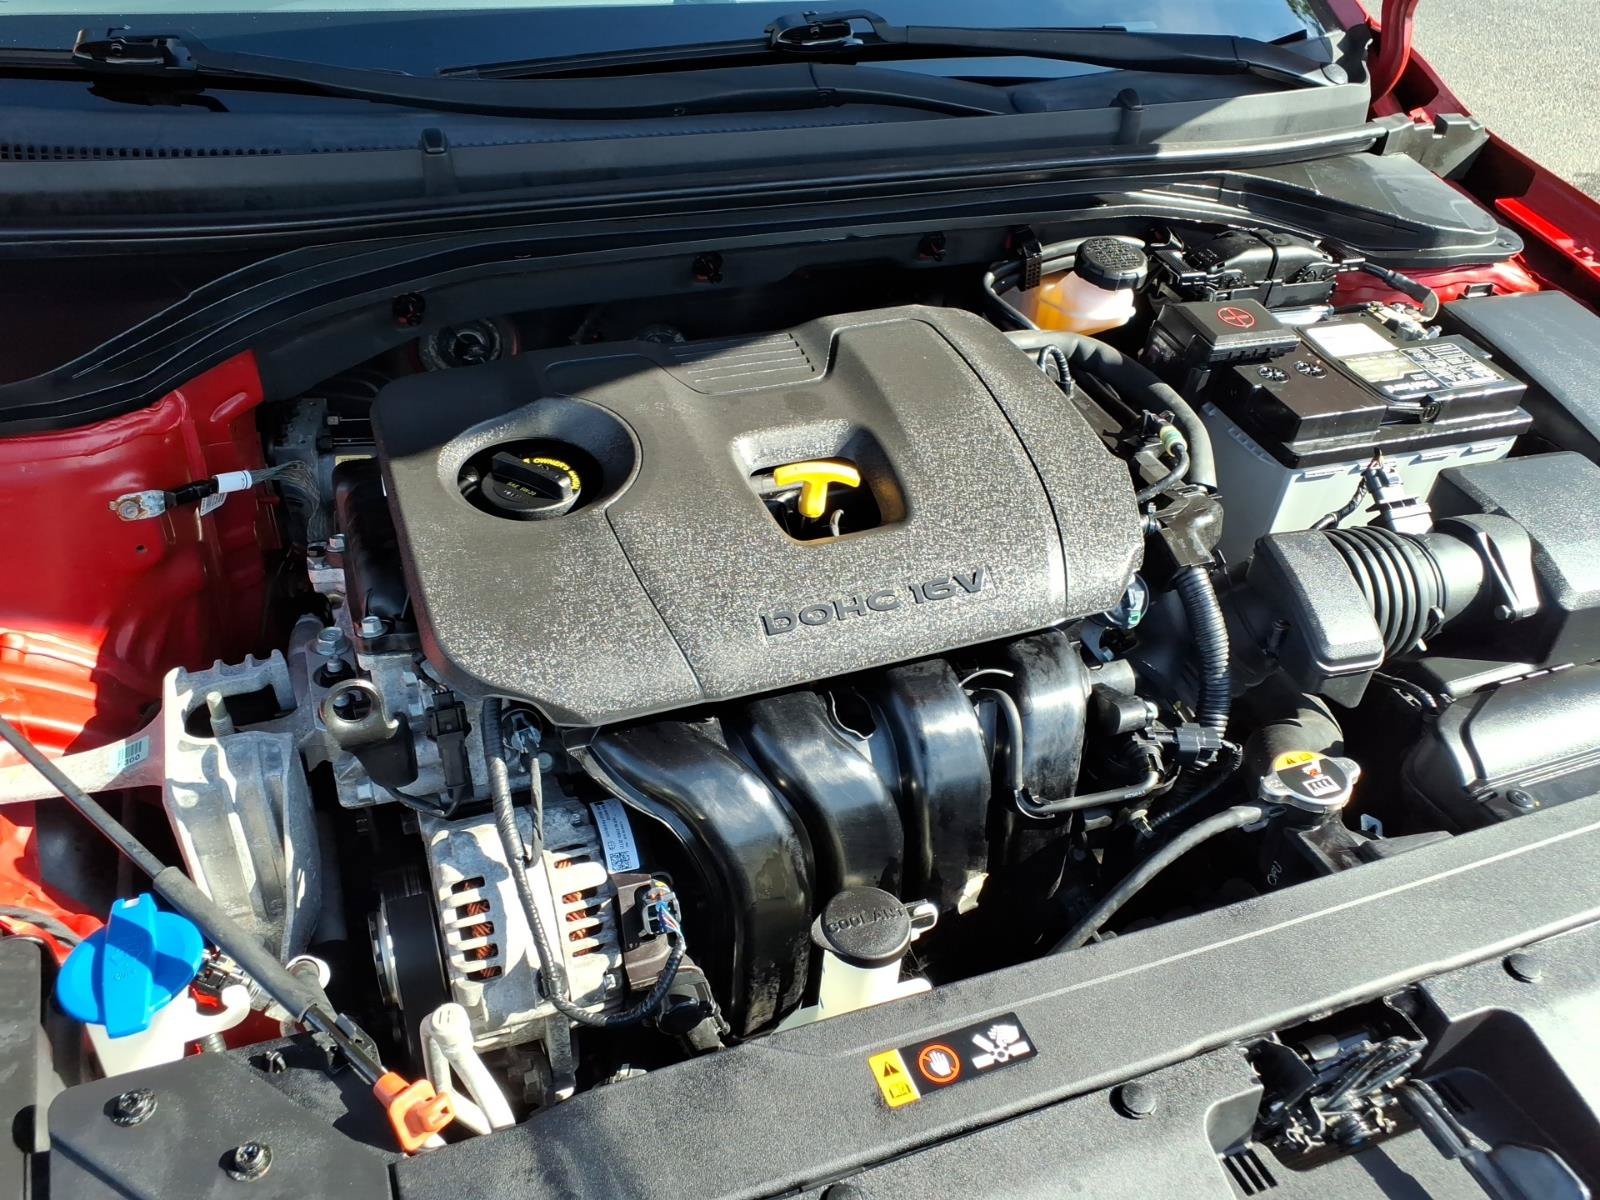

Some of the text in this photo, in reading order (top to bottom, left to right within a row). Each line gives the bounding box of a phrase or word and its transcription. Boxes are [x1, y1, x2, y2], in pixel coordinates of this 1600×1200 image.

[759, 567, 986, 637] DOHC 16V
[827, 908, 905, 933] COOLANT
